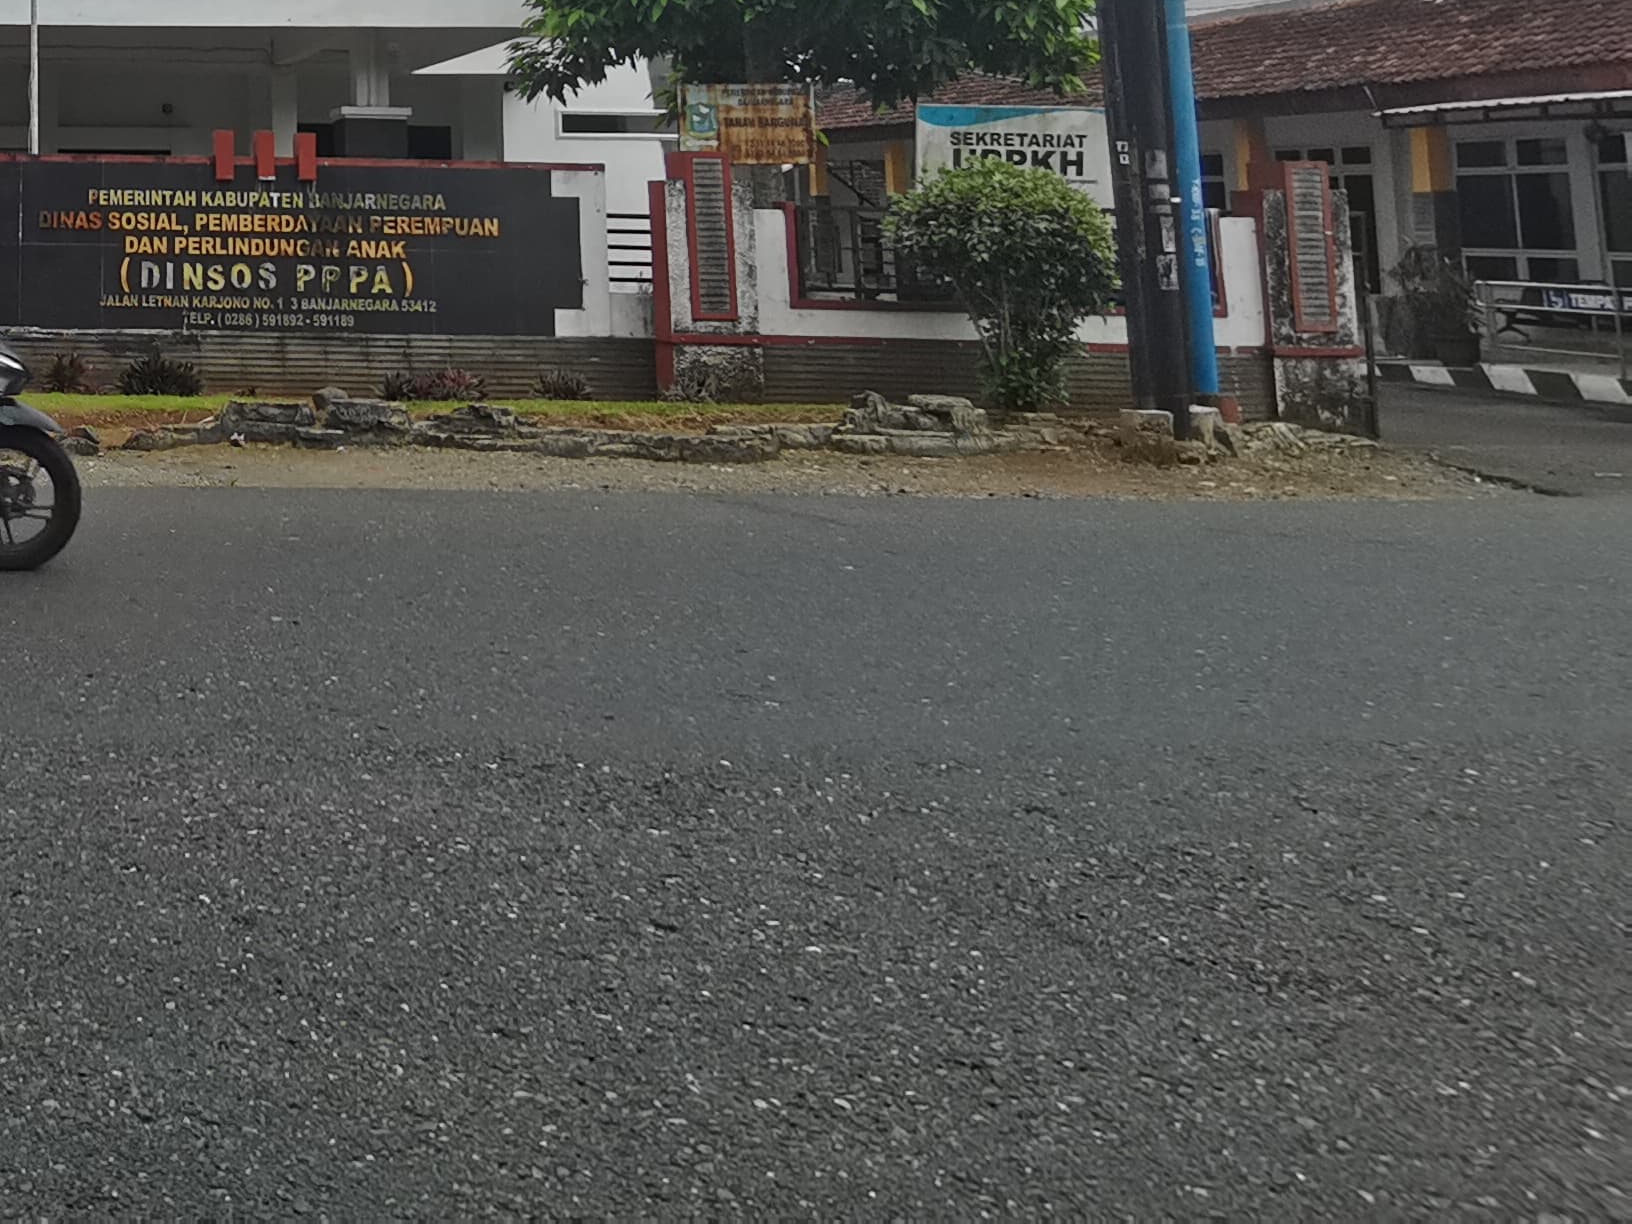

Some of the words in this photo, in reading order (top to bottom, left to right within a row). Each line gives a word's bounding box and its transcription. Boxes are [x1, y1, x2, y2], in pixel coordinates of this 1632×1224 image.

[949, 131, 1088, 149] SEKRETARIAT
[88, 188, 197, 207] PEMERINTAH
[201, 190, 304, 209] KABUPATEN
[308, 192, 447, 211] BANJARNEGARA
[38, 210, 103, 230] DINAS
[107, 211, 189, 235] SOSIAL,
[195, 213, 364, 234] PEMBERDAYAAN
[369, 215, 500, 237] PEREMPUAN
[125, 235, 169, 254] DAN
[174, 236, 342, 257] PERLINDUNGAN
[345, 240, 407, 258] ANAK
[99, 294, 139, 307] JALAN
[141, 294, 189, 308] LETNAN
[192, 295, 250, 309] KARJONO
[252, 295, 275, 309] NO.
[300, 297, 400, 312] BANJARNEGARA
[401, 299, 438, 313] 53412
